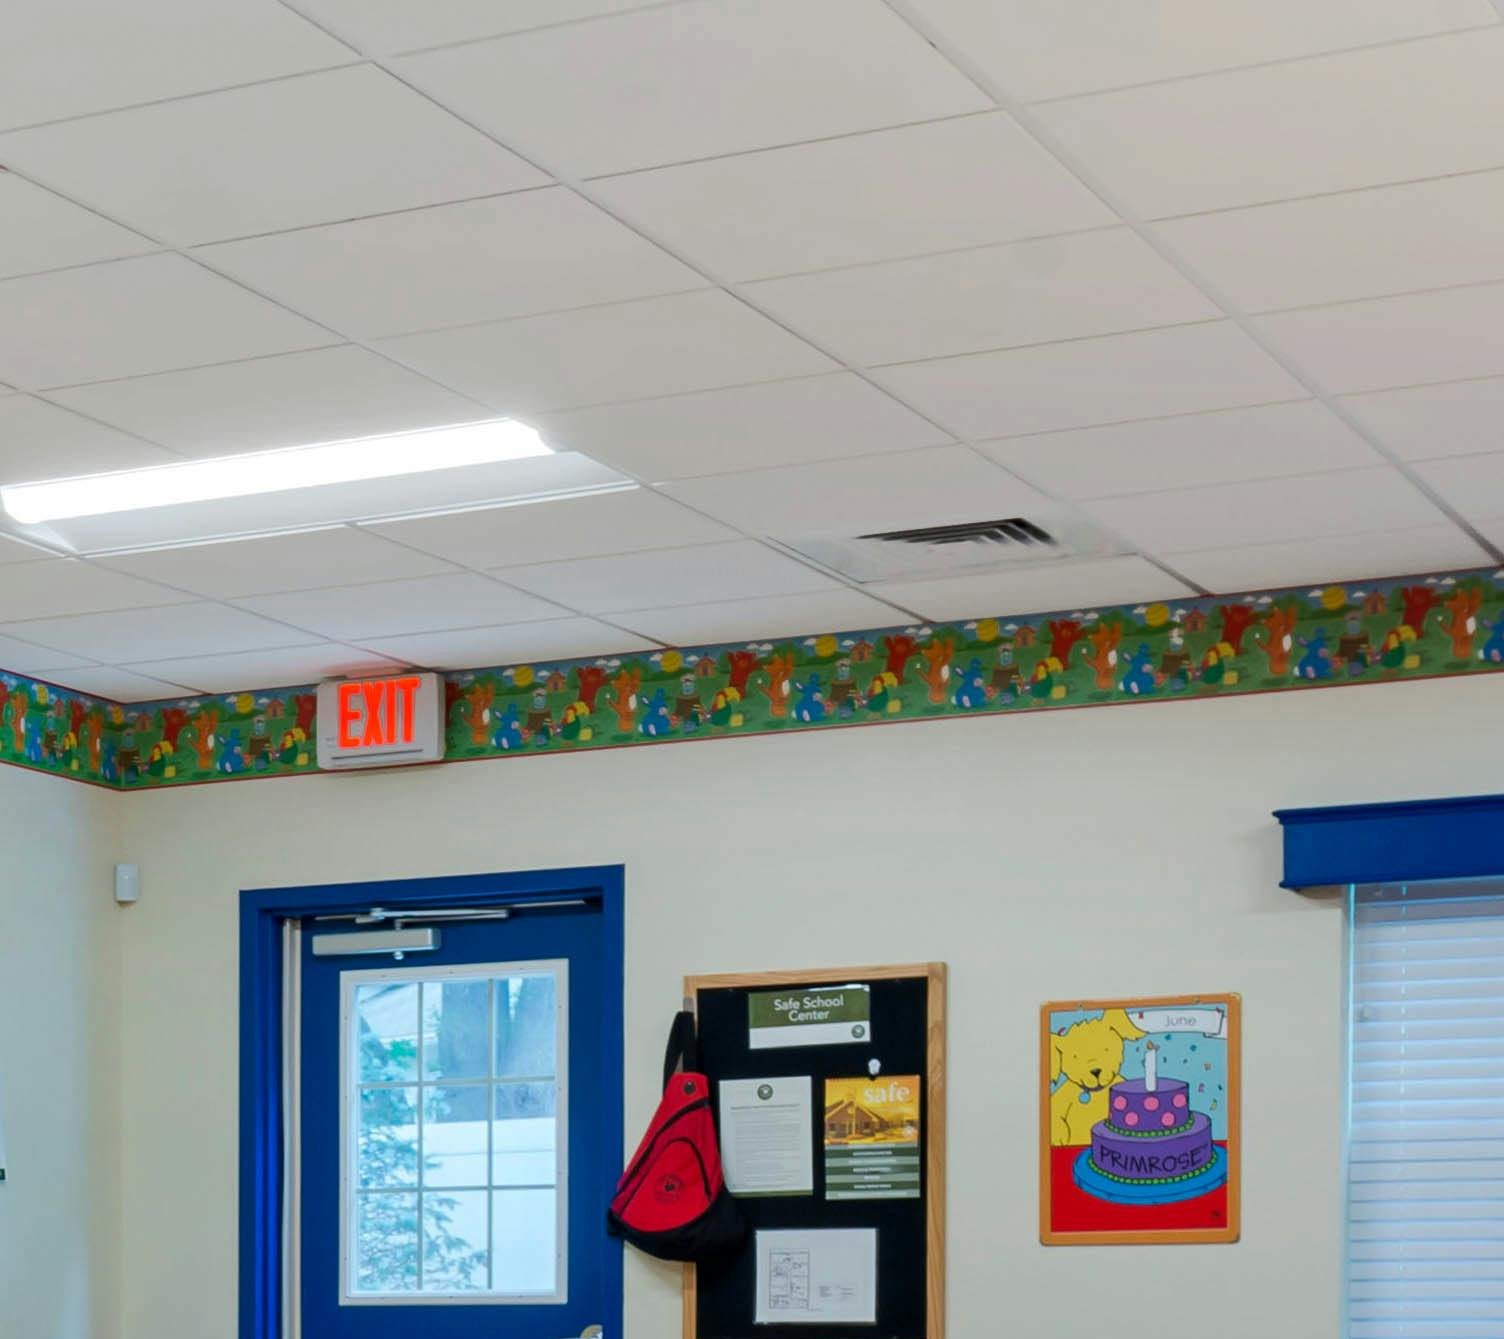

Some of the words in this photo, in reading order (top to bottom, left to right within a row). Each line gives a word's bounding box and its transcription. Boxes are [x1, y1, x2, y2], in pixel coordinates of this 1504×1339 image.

[338, 676, 421, 749] EXIT
[774, 997, 800, 1011] Safe
[803, 994, 844, 1009] School
[788, 1009, 830, 1022] Center
[1165, 1015, 1197, 1027] June
[864, 1082, 911, 1104] safe
[1099, 1144, 1203, 1174] PRIMROSE
